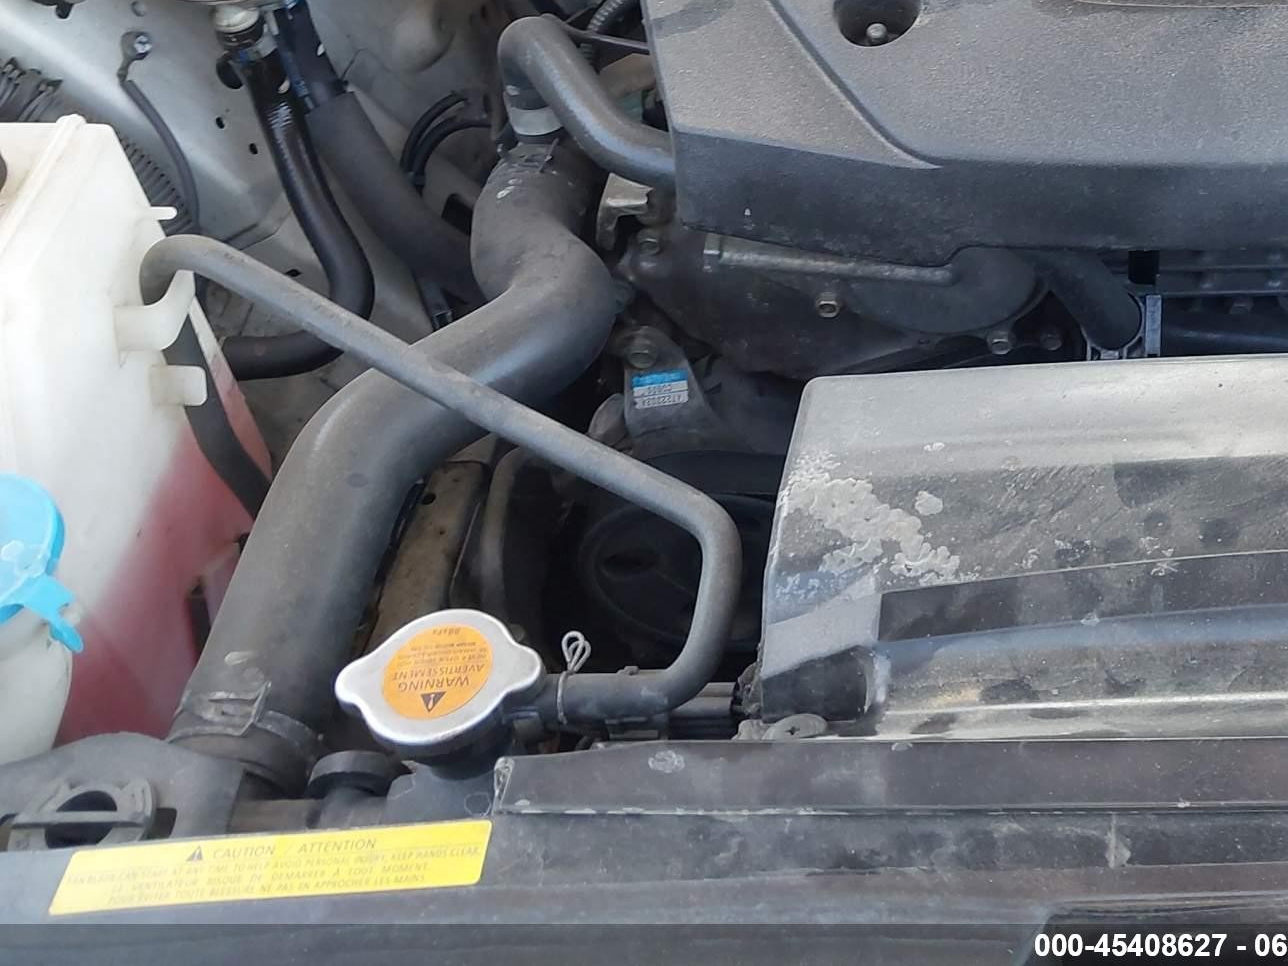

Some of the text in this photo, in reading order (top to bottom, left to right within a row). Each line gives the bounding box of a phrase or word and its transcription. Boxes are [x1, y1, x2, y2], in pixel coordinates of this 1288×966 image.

[392, 663, 486, 682] AVERTISSEMENT
[398, 676, 470, 692] WARNING
[213, 845, 277, 860] CAUTION
[297, 838, 377, 854] ATTENTION
